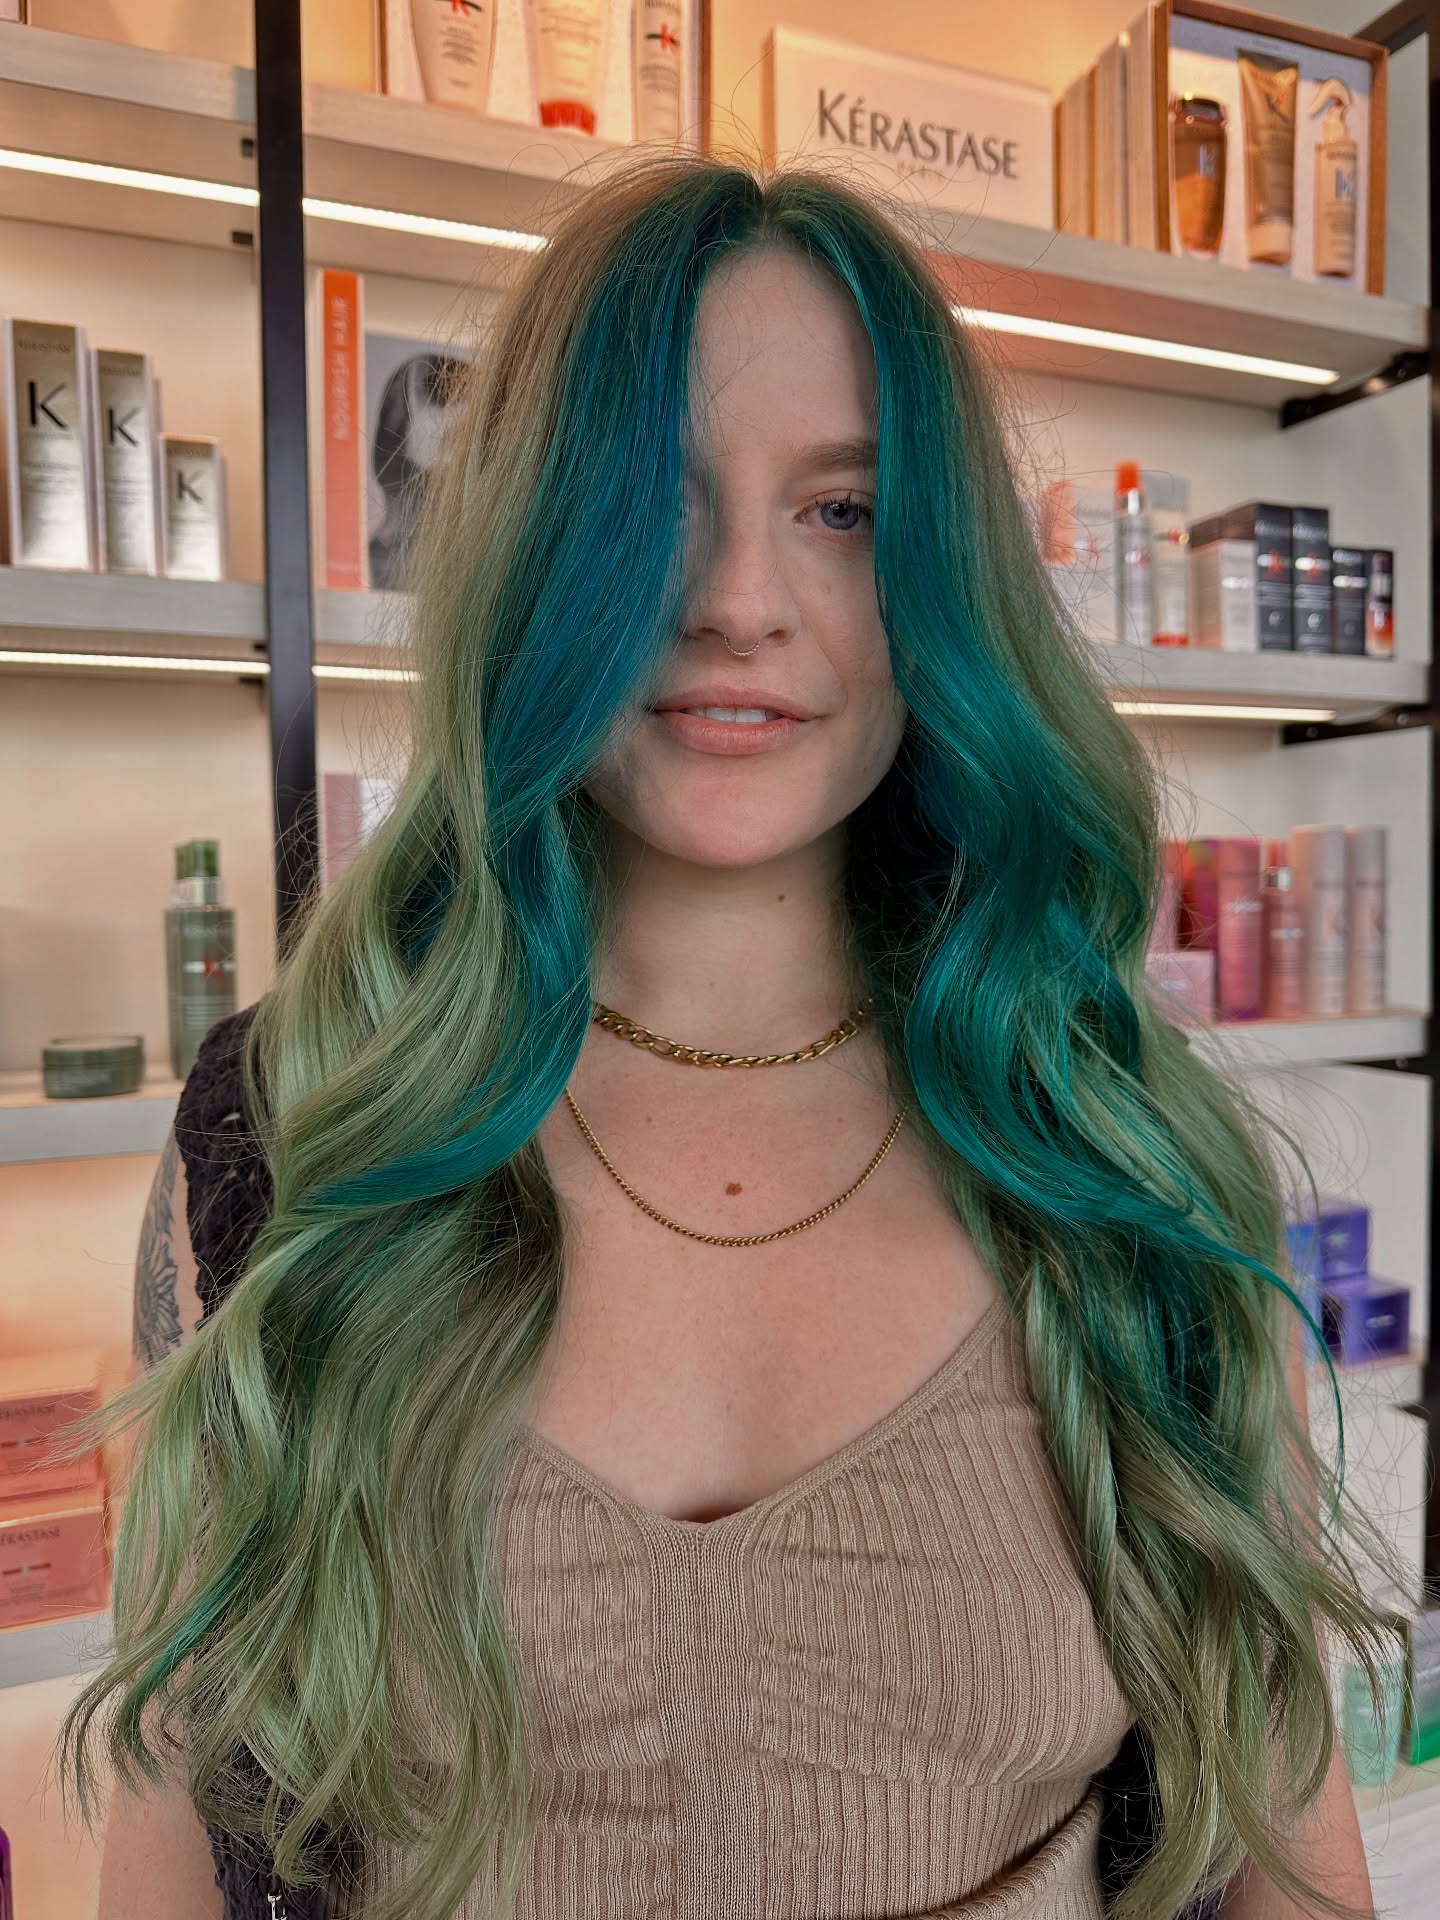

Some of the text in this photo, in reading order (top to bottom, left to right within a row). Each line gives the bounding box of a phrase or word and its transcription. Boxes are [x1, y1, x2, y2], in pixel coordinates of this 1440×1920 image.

[818, 87, 1020, 180] KÉRASTASE
[28, 380, 68, 431] K
[107, 407, 140, 448] K
[176, 469, 205, 504] K
